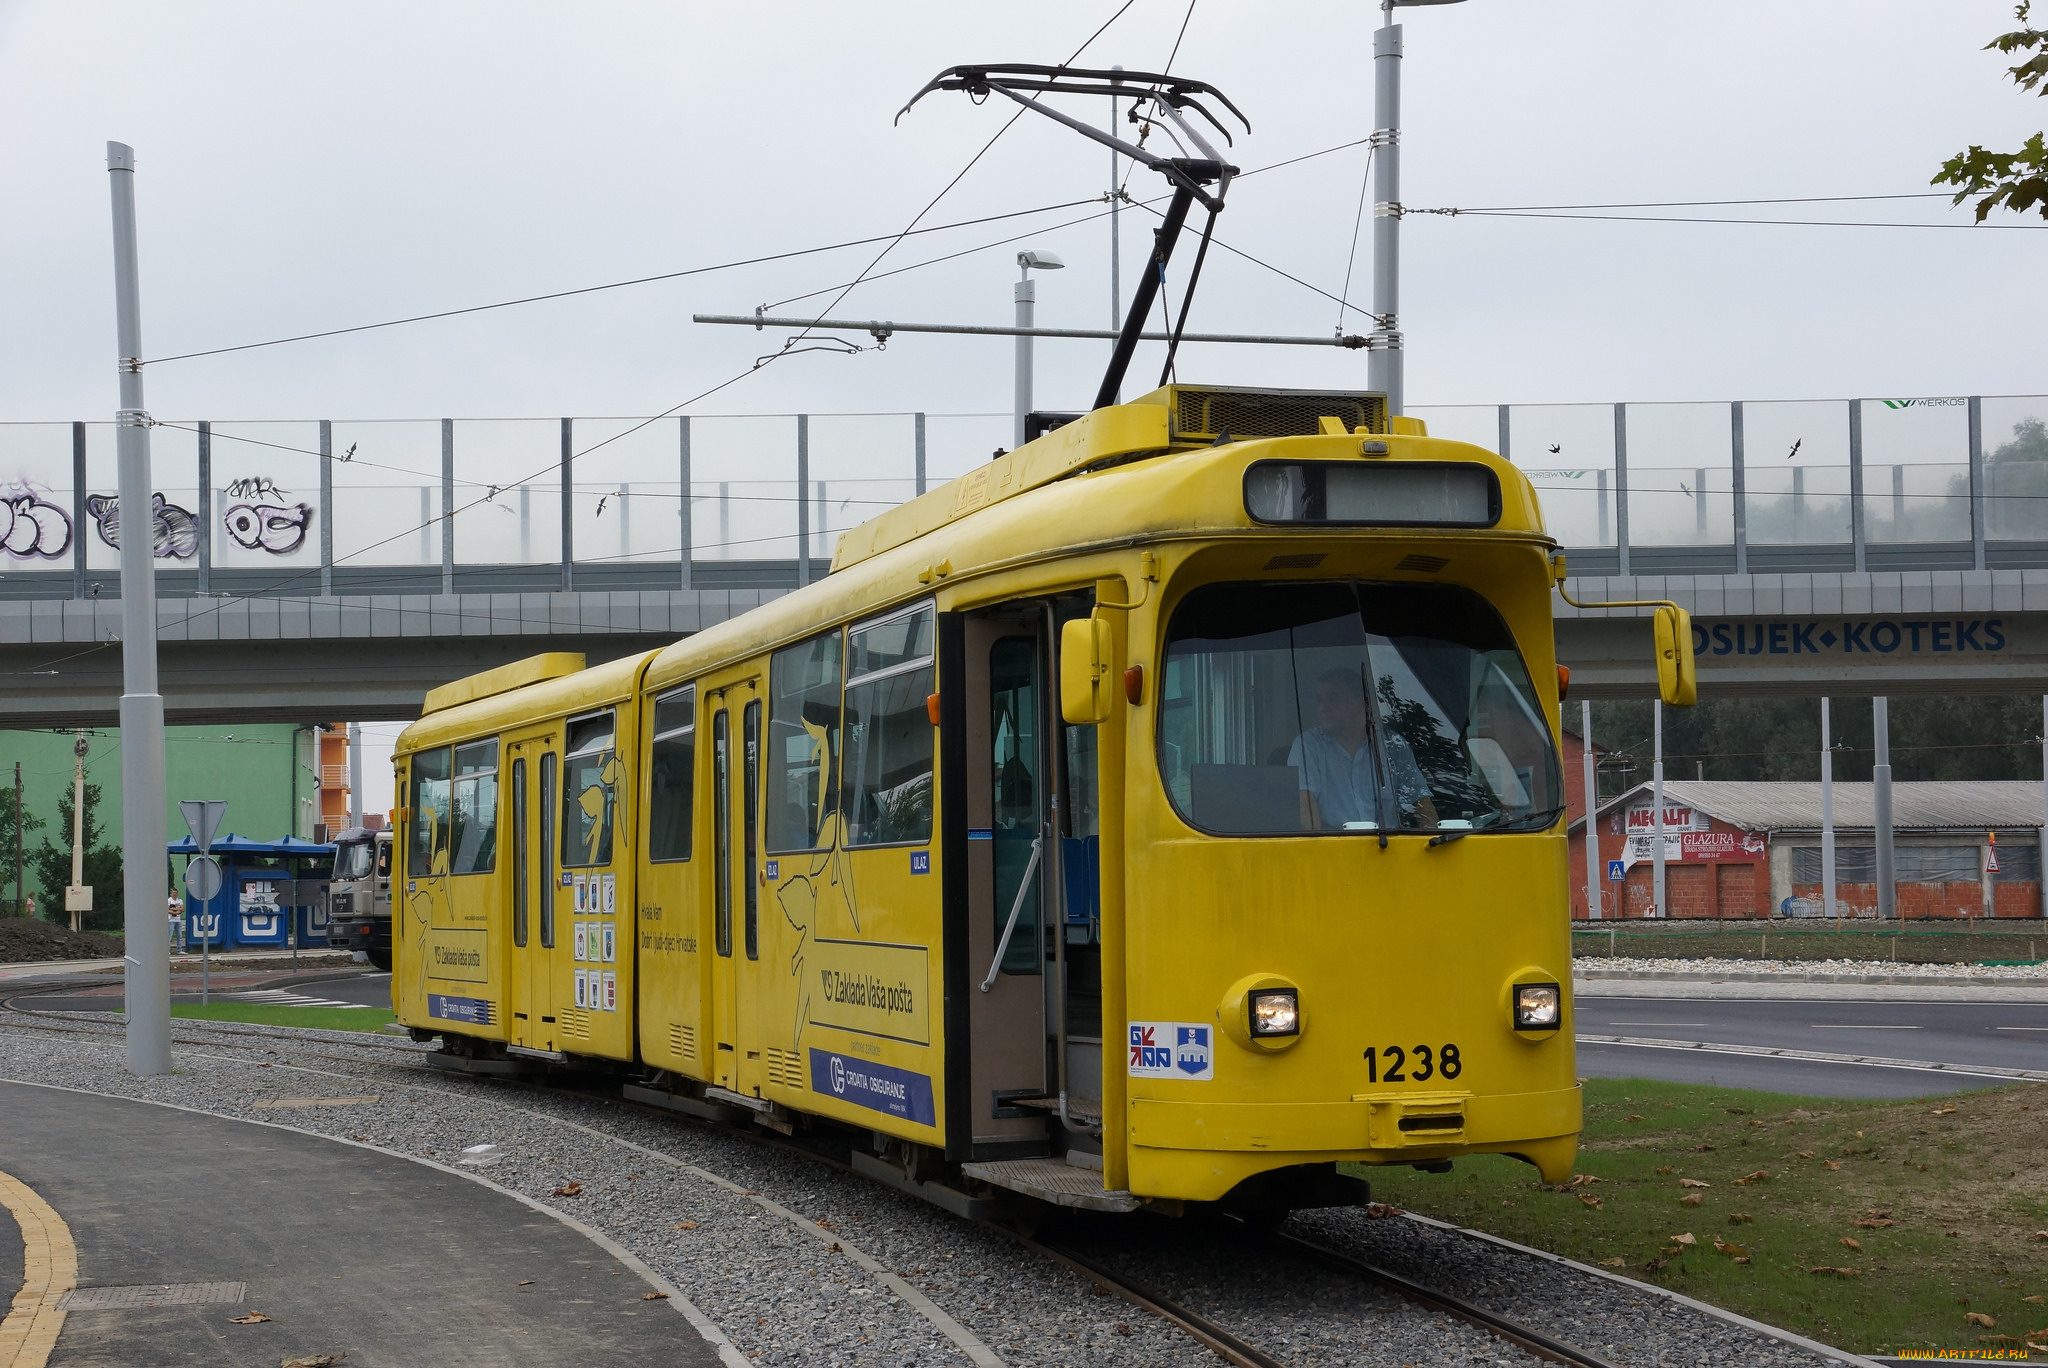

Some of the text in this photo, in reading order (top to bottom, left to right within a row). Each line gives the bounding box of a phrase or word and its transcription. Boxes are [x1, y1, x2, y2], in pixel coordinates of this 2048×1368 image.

[1917, 397, 1965, 407] WERKOS
[1691, 619, 2005, 655] OSIJEK KOTEKS
[1683, 833, 1734, 845] GLAZURA
[767, 864, 777, 876] IZLAZ
[913, 855, 927, 870] ULAZ
[641, 902, 662, 920] Hvala Vam
[641, 931, 653, 949] Dobri
[676, 933, 697, 953] Hrvatske
[441, 946, 457, 966] Zaklada
[468, 949, 480, 969] pošta
[834, 971, 913, 1016] Zaklada Vaša pošta
[1363, 1043, 1462, 1083] 1238
[846, 1070, 868, 1090] CROATIA
[869, 1076, 906, 1100] OSIGURANJE
